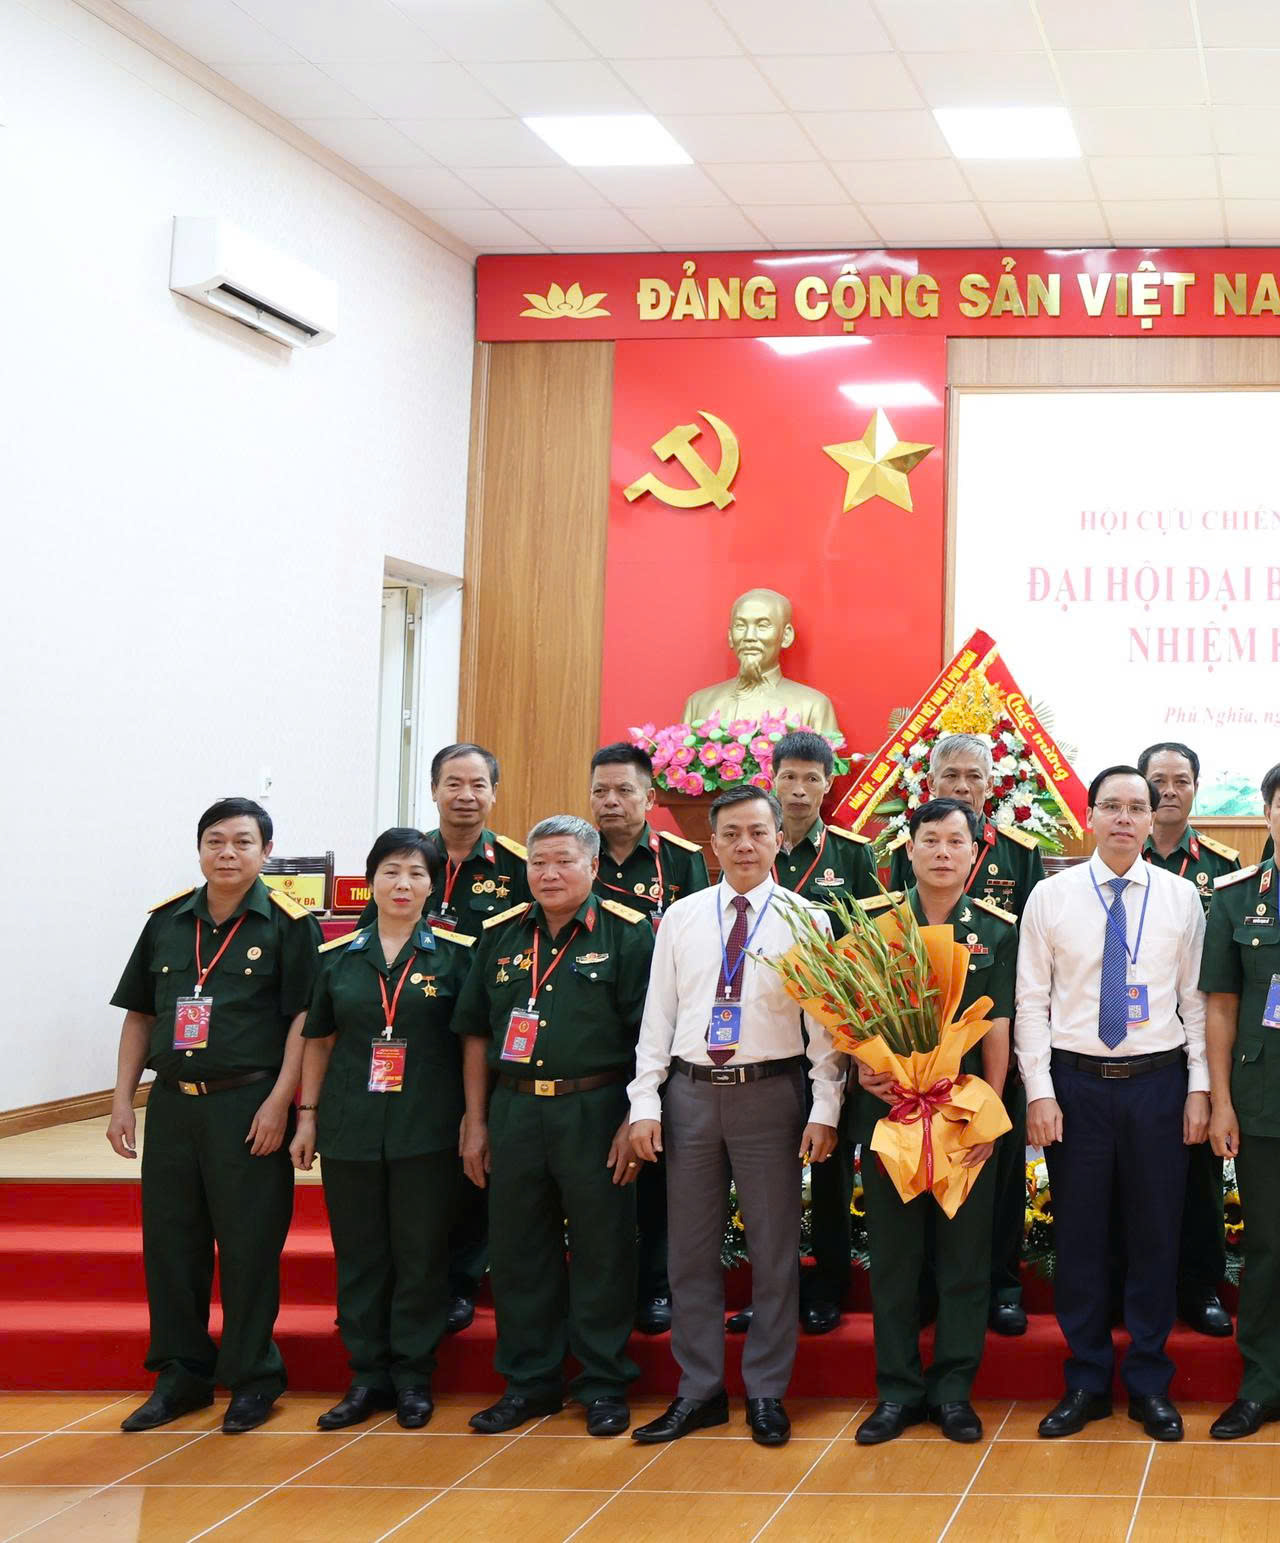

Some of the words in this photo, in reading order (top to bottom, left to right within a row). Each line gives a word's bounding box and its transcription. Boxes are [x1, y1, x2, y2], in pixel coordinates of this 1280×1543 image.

[637, 261, 776, 320] ĐẢNG
[795, 263, 939, 331] CỘNG
[960, 257, 1060, 317] SẢN
[1080, 261, 1195, 328] VIỆT
[1080, 504, 1127, 536] HỘI
[1136, 508, 1192, 536] CỰU
[1026, 566, 1093, 612] ĐẠI
[1104, 560, 1176, 612] HỘI
[1186, 566, 1252, 612] ĐẠI
[1128, 621, 1256, 673] NHIỆM
[1007, 692, 1036, 733] Chúc
[1032, 732, 1069, 781] mừng
